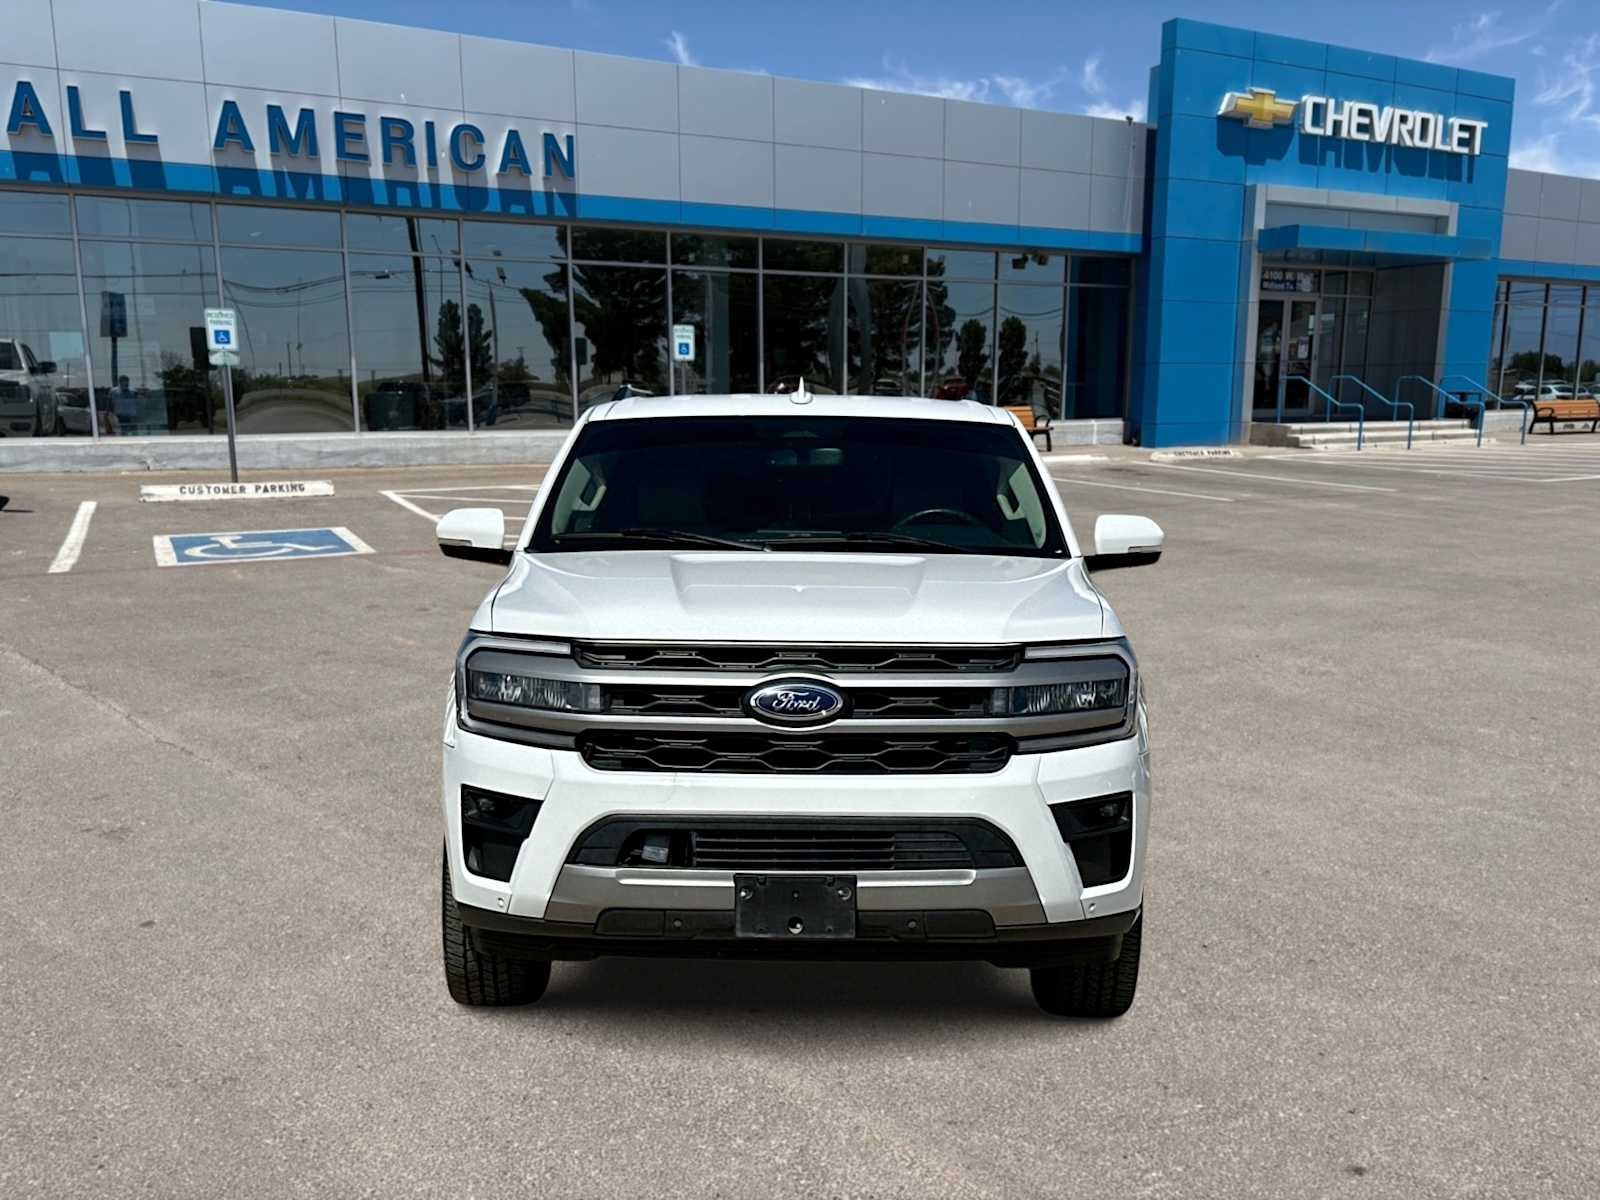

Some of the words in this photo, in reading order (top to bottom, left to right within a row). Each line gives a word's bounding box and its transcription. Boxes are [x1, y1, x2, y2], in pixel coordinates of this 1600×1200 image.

[7, 80, 159, 144] ALL
[213, 100, 576, 179] AMERICAN
[1301, 94, 1488, 155] CHEVROLET
[179, 485, 246, 495] CUSTOMER
[254, 483, 305, 493] PARKING
[772, 690, 821, 711] Ford
